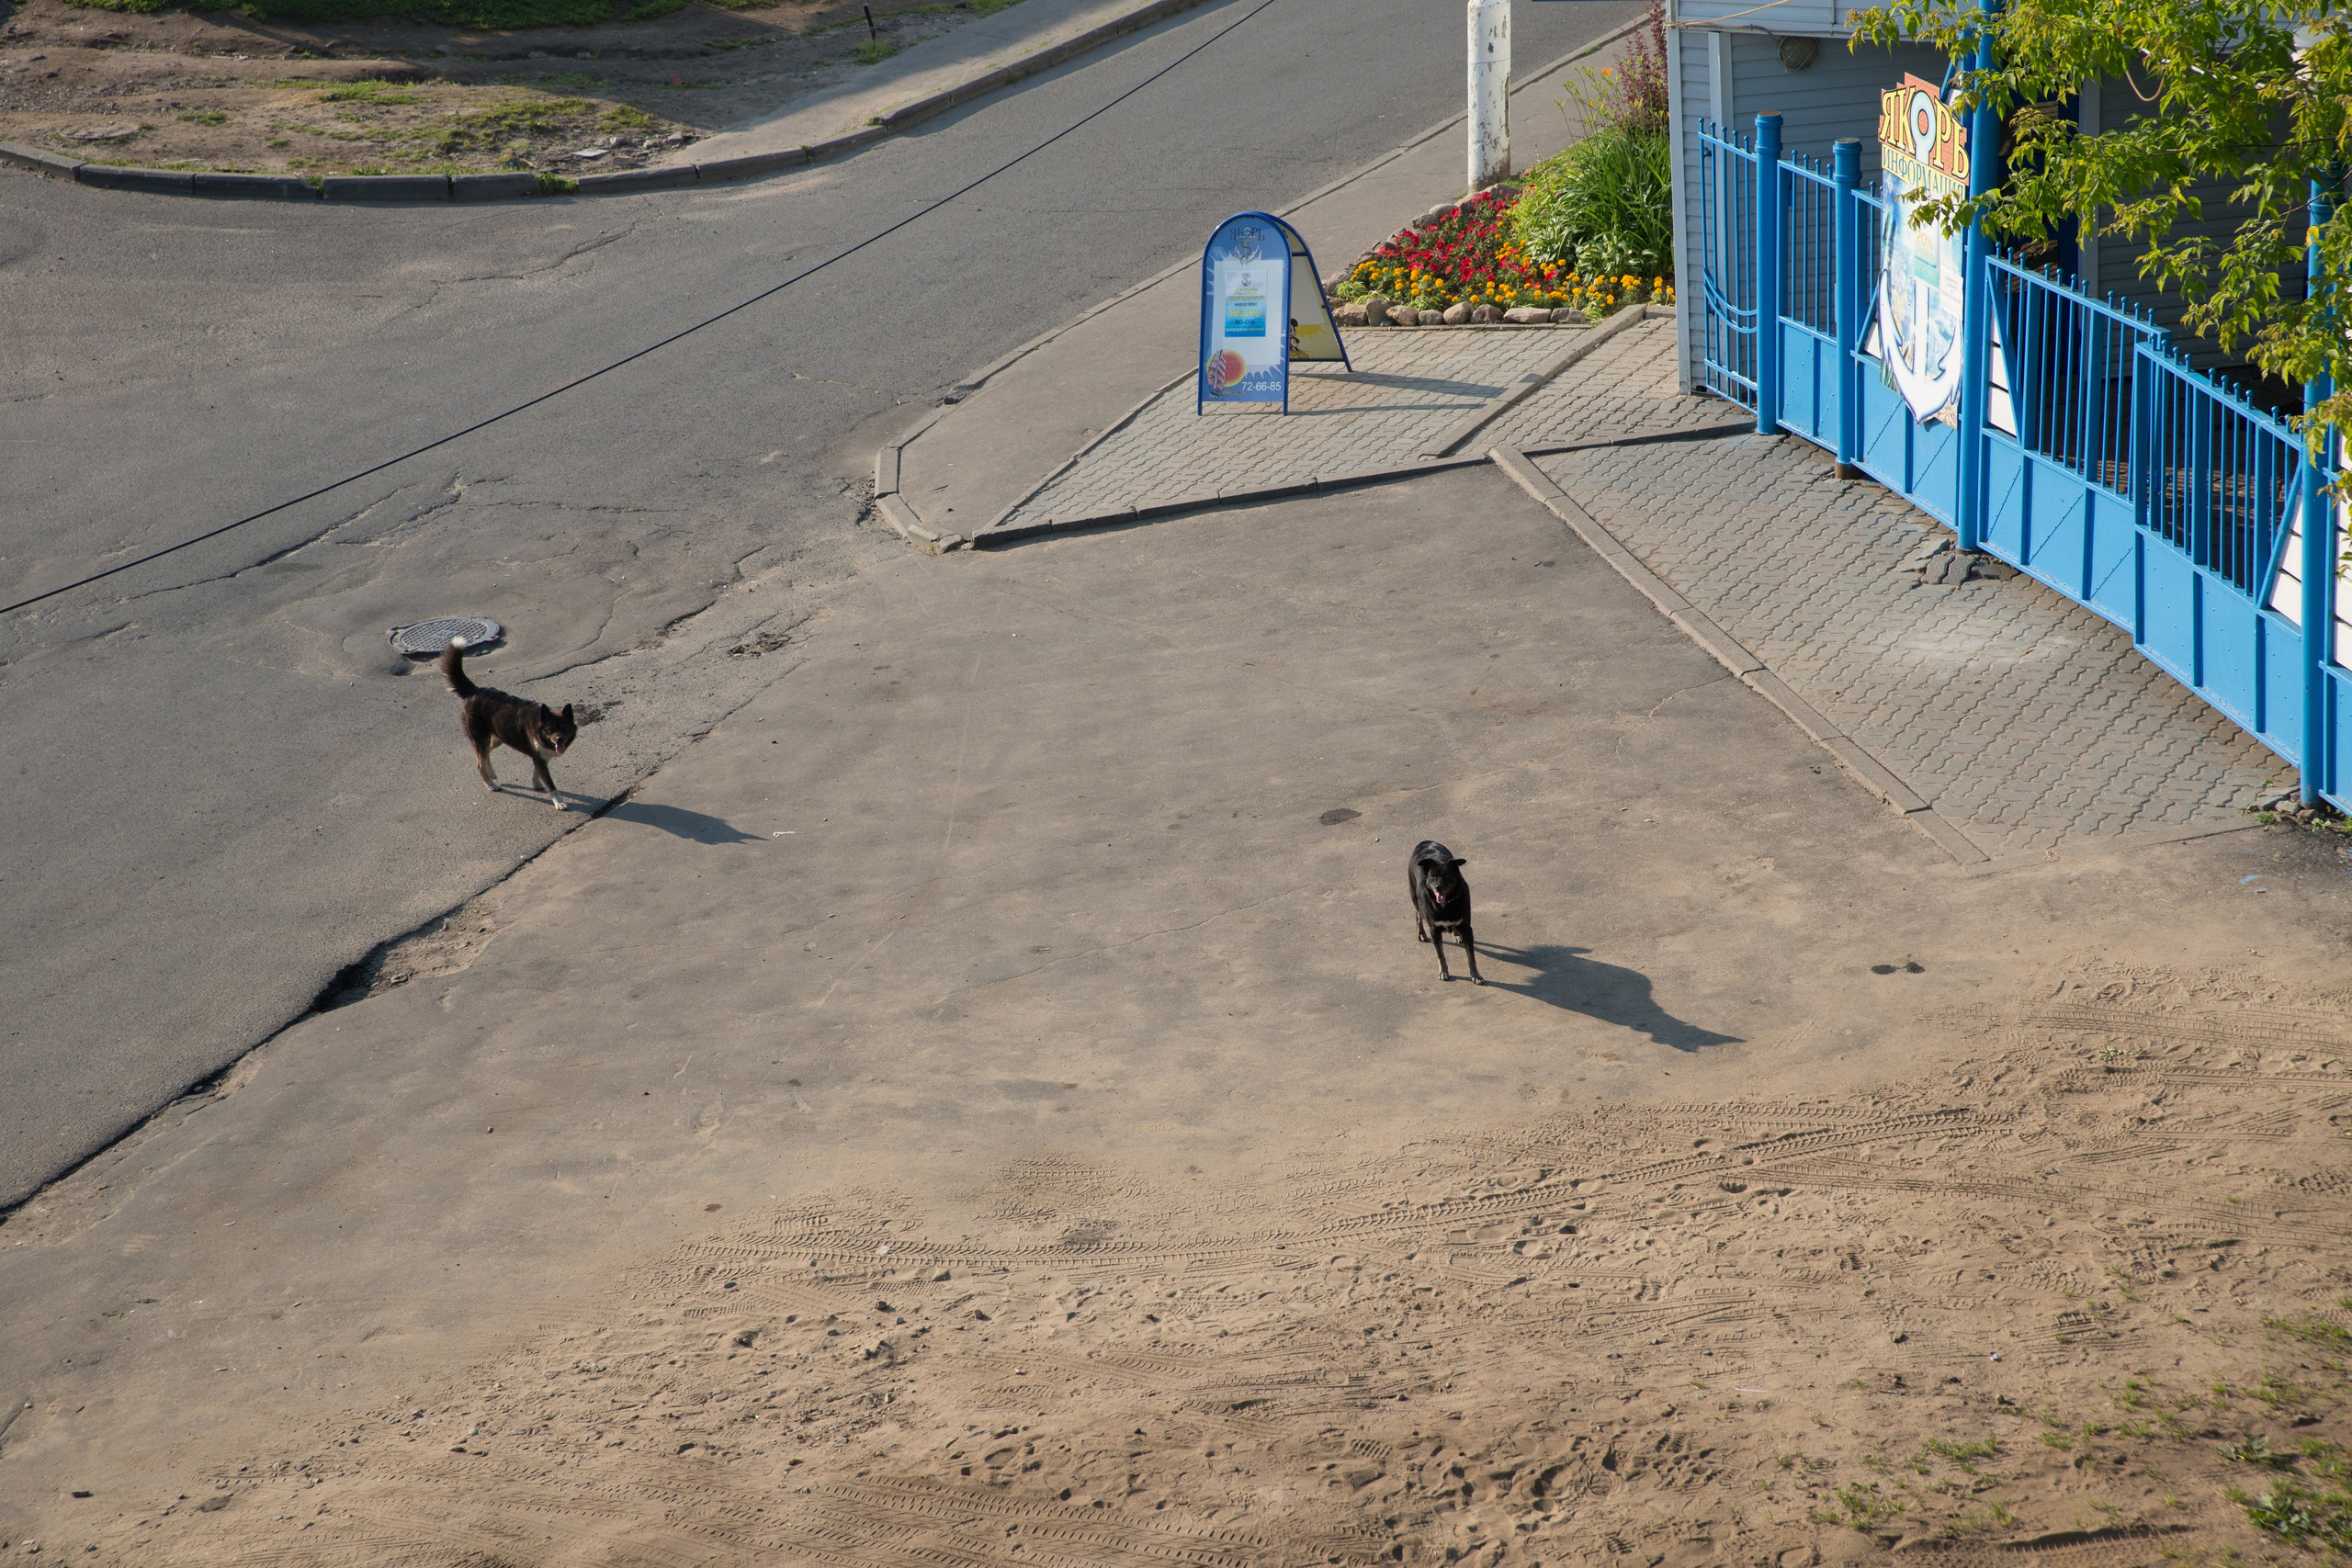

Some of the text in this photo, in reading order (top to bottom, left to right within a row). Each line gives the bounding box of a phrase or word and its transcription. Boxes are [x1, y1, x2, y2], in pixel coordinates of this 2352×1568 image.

[1879, 85, 1970, 179] ЯКОРЬ
[1883, 145, 1964, 204] ИНФОРМАЦИЯ
[1228, 227, 1265, 242] ЯКОРЬ
[1916, 230, 1934, 251] 20%
[1229, 309, 1261, 318] ЯКОРЬ
[1241, 381, 1282, 391] 72-66-85
